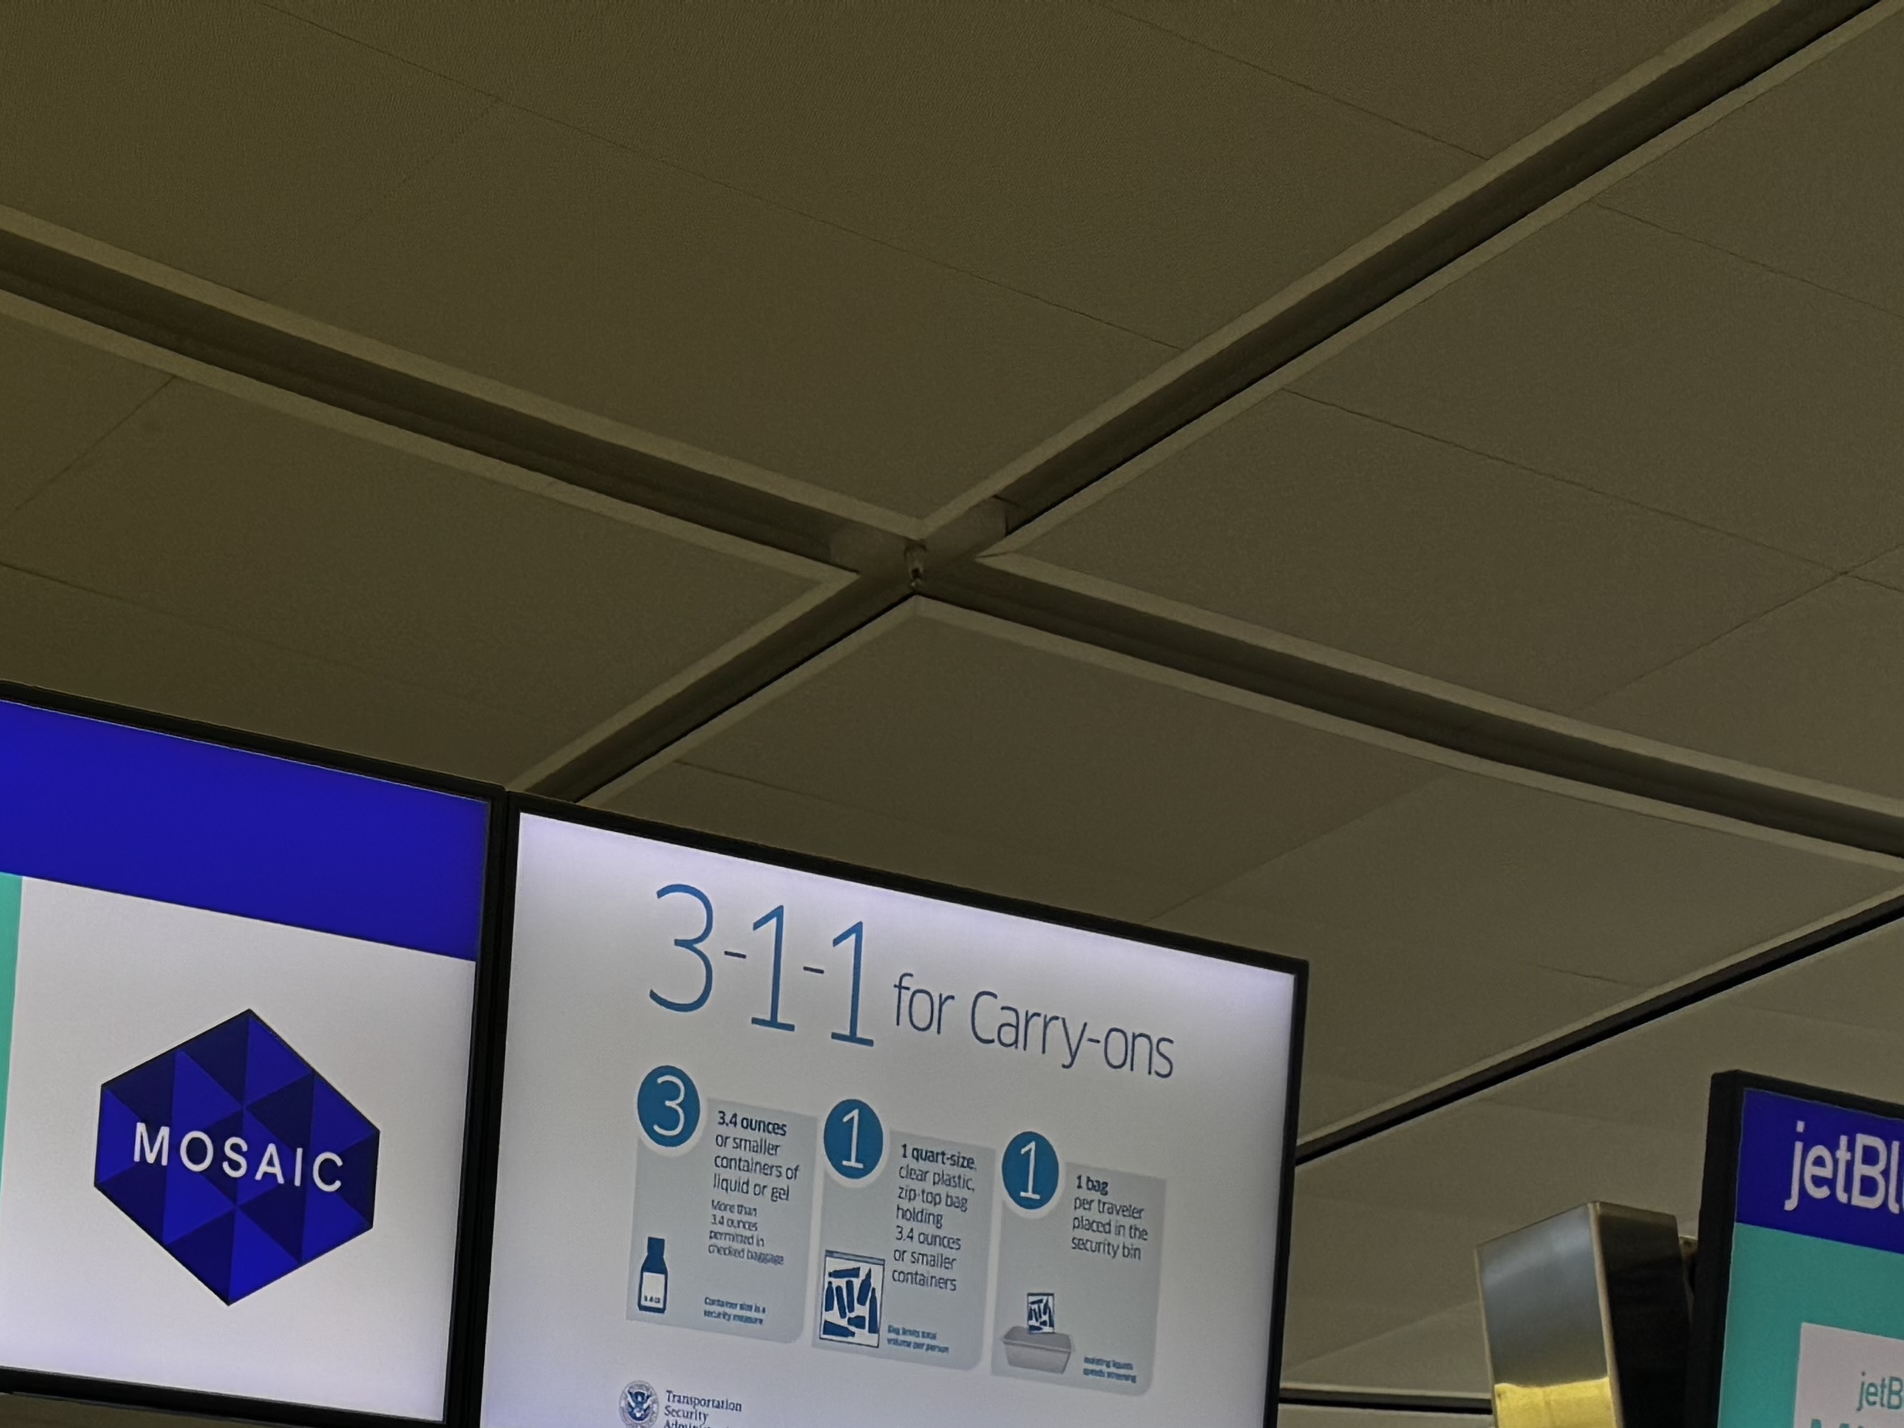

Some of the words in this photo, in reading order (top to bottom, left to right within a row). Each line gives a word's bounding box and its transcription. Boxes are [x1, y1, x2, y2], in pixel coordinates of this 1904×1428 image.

[649, 884, 874, 1047] 3-1-1
[892, 973, 954, 1035] for
[970, 990, 1175, 1080] Carry-ons
[653, 1074, 685, 1137] 3
[718, 1110, 738, 1127] 3.4
[741, 1117, 787, 1136] ounces
[716, 1133, 730, 1148] or
[733, 1136, 780, 1156] smaller
[842, 1108, 864, 1168] 1
[133, 1122, 343, 1192] MOSAIC
[901, 1144, 907, 1159] 1
[714, 1155, 782, 1178] containers
[786, 1165, 800, 1181] of
[899, 1164, 929, 1183] clear
[933, 1169, 975, 1192] plastic,
[1020, 1141, 1041, 1199] 1
[1784, 1120, 1904, 1215] jetBl
[713, 1173, 749, 1196] liquid
[753, 1181, 767, 1196] or
[771, 1184, 790, 1202] gel
[1076, 1175, 1082, 1189] 1
[1086, 1176, 1108, 1195] bag
[712, 1200, 734, 1215] More
[737, 1204, 758, 1217] than
[945, 1195, 968, 1212] bag
[1074, 1196, 1094, 1211] per
[1098, 1199, 1144, 1219] traveler
[896, 1205, 943, 1228] holding
[1072, 1215, 1111, 1235] placed
[1115, 1223, 1125, 1236] in
[1129, 1224, 1148, 1241] the
[896, 1225, 914, 1242] 3.4
[918, 1231, 961, 1250] ounces
[1071, 1236, 1119, 1259] security
[1122, 1243, 1142, 1260] bin
[894, 1249, 908, 1262] or
[911, 1251, 956, 1270] smaller
[892, 1268, 957, 1291] containers
[666, 1390, 742, 1412] Transportation
[664, 1405, 708, 1424] Security
